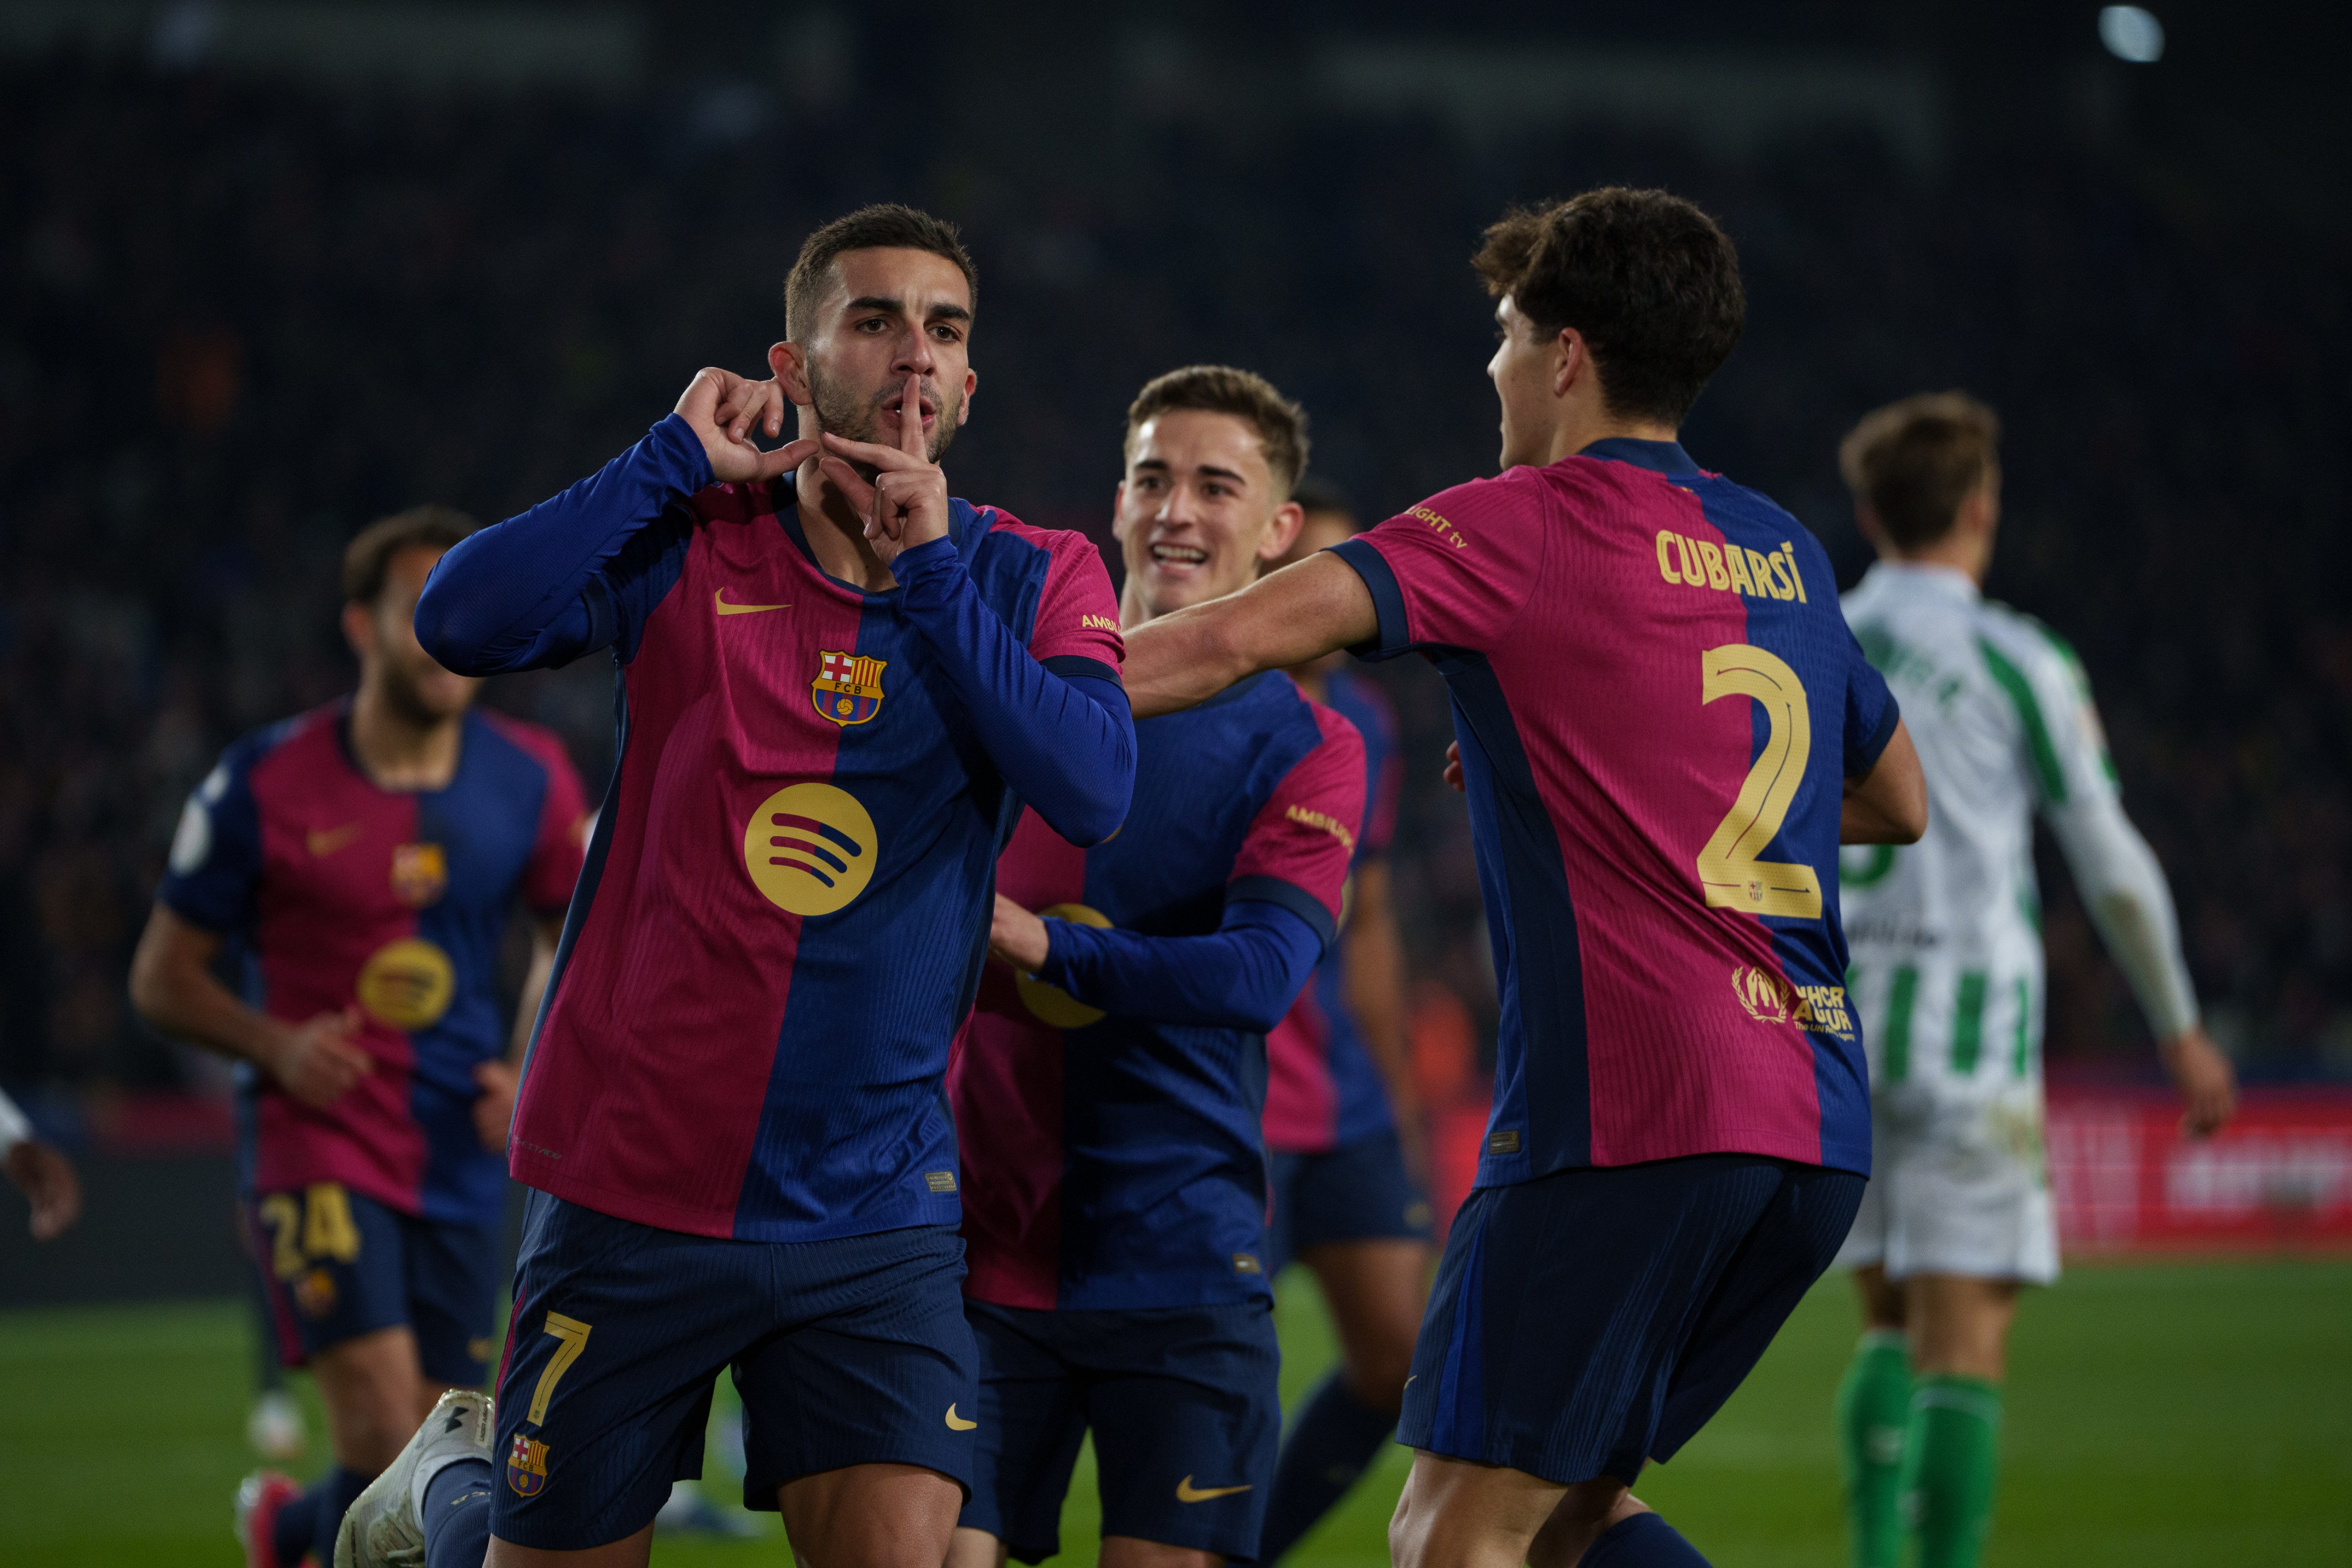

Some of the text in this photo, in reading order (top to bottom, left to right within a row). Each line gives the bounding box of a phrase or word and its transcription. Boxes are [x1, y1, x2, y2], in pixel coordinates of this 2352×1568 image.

[1449, 531, 1467, 549] tv
[1656, 529, 1808, 604] CUBARSÍ
[834, 682, 862, 694] FCB
[1697, 644, 1822, 919] 2
[260, 1182, 363, 1279] 24
[527, 1310, 593, 1427] 7
[518, 1460, 534, 1472] FCB
